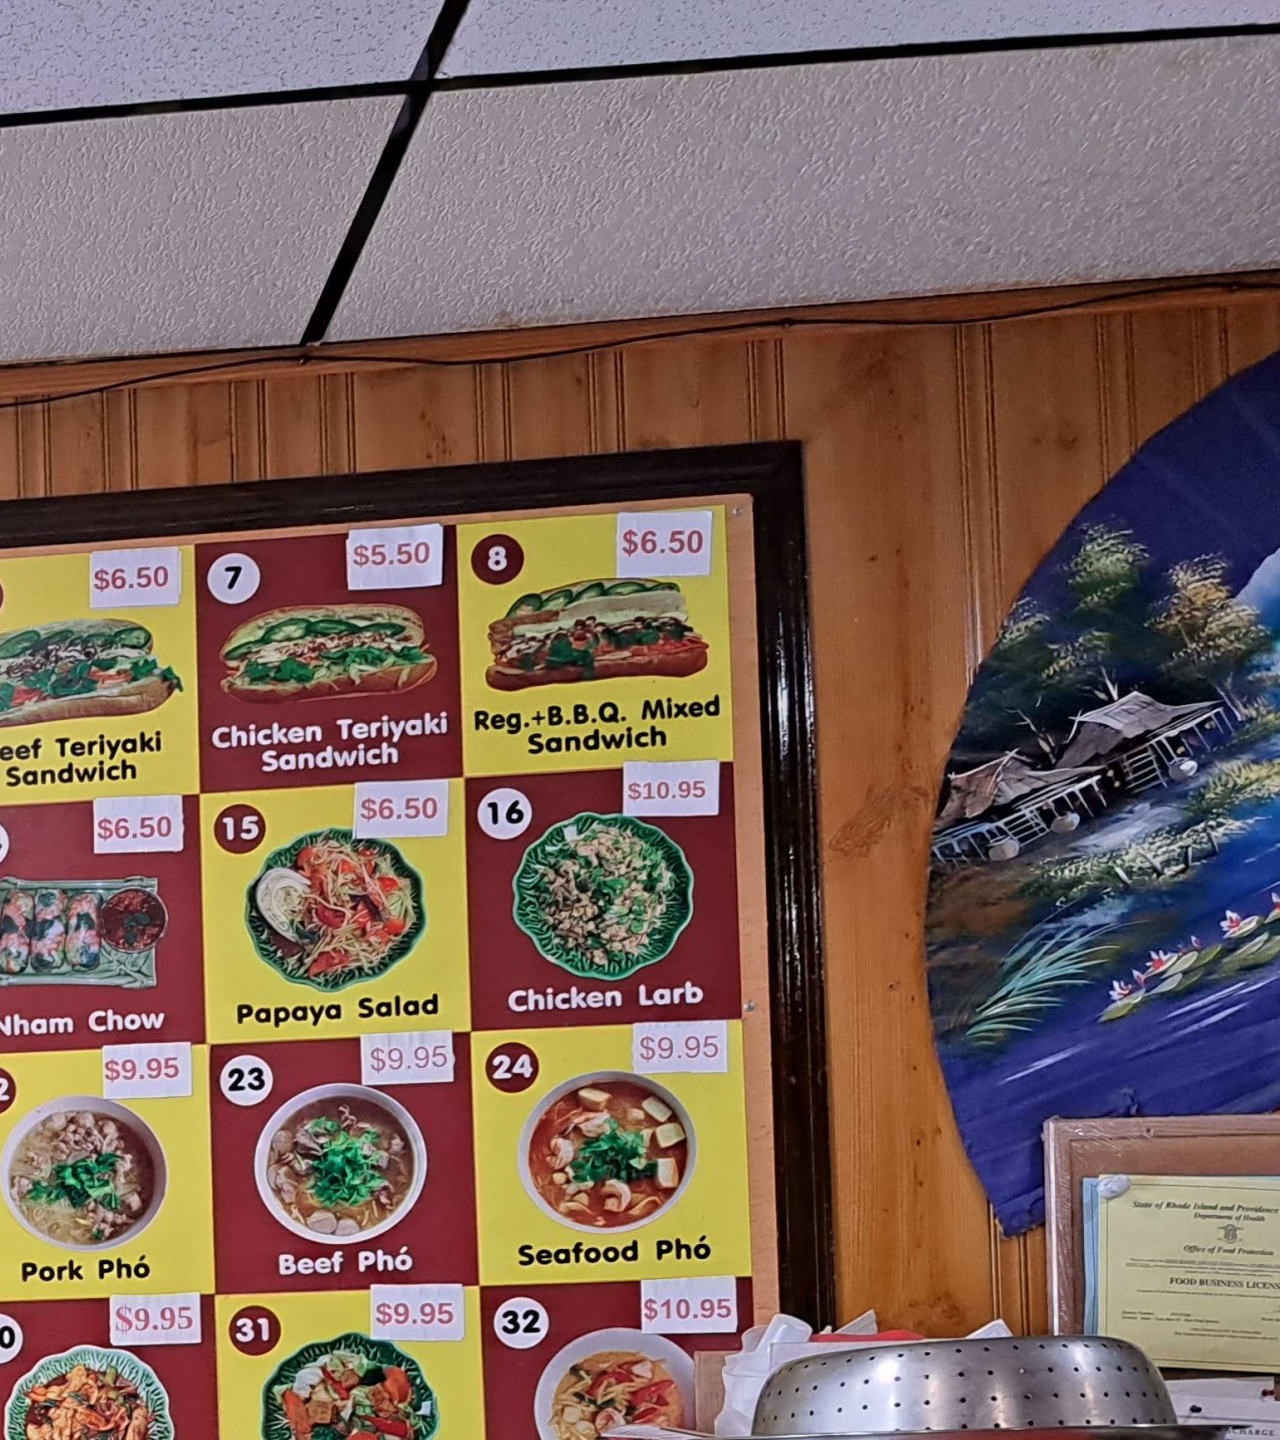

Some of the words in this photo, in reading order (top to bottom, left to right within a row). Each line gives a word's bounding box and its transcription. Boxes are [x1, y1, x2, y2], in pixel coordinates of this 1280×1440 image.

[622, 530, 704, 556] $6.50
[642, 696, 720, 719] Mixed
[212, 721, 322, 748] Chicken
[338, 712, 448, 742] Teriyaki
[528, 727, 667, 754] Sandwich
[56, 732, 162, 759] Teriyaki
[261, 743, 399, 772] Sandwich
[6, 761, 137, 787] Sandwich
[360, 798, 438, 821] $6.50
[238, 998, 341, 1027] Papaya
[358, 994, 439, 1017] Salad
[509, 988, 621, 1013] Chicken
[639, 982, 702, 1005] Larb
[89, 1008, 164, 1032] Chow
[370, 1046, 447, 1072] $9.95
[278, 1253, 343, 1276] Beef
[359, 1246, 413, 1273] Phó
[518, 1241, 638, 1266] Seafood
[656, 1235, 711, 1261] Phó
[22, 1260, 83, 1282] Pork
[98, 1255, 150, 1280] Phó
[1170, 1277, 1197, 1285] FOOD
[1199, 1279, 1243, 1288] BUSINESS
[116, 1305, 193, 1332] $9.95
[236, 1318, 269, 1342] 31
